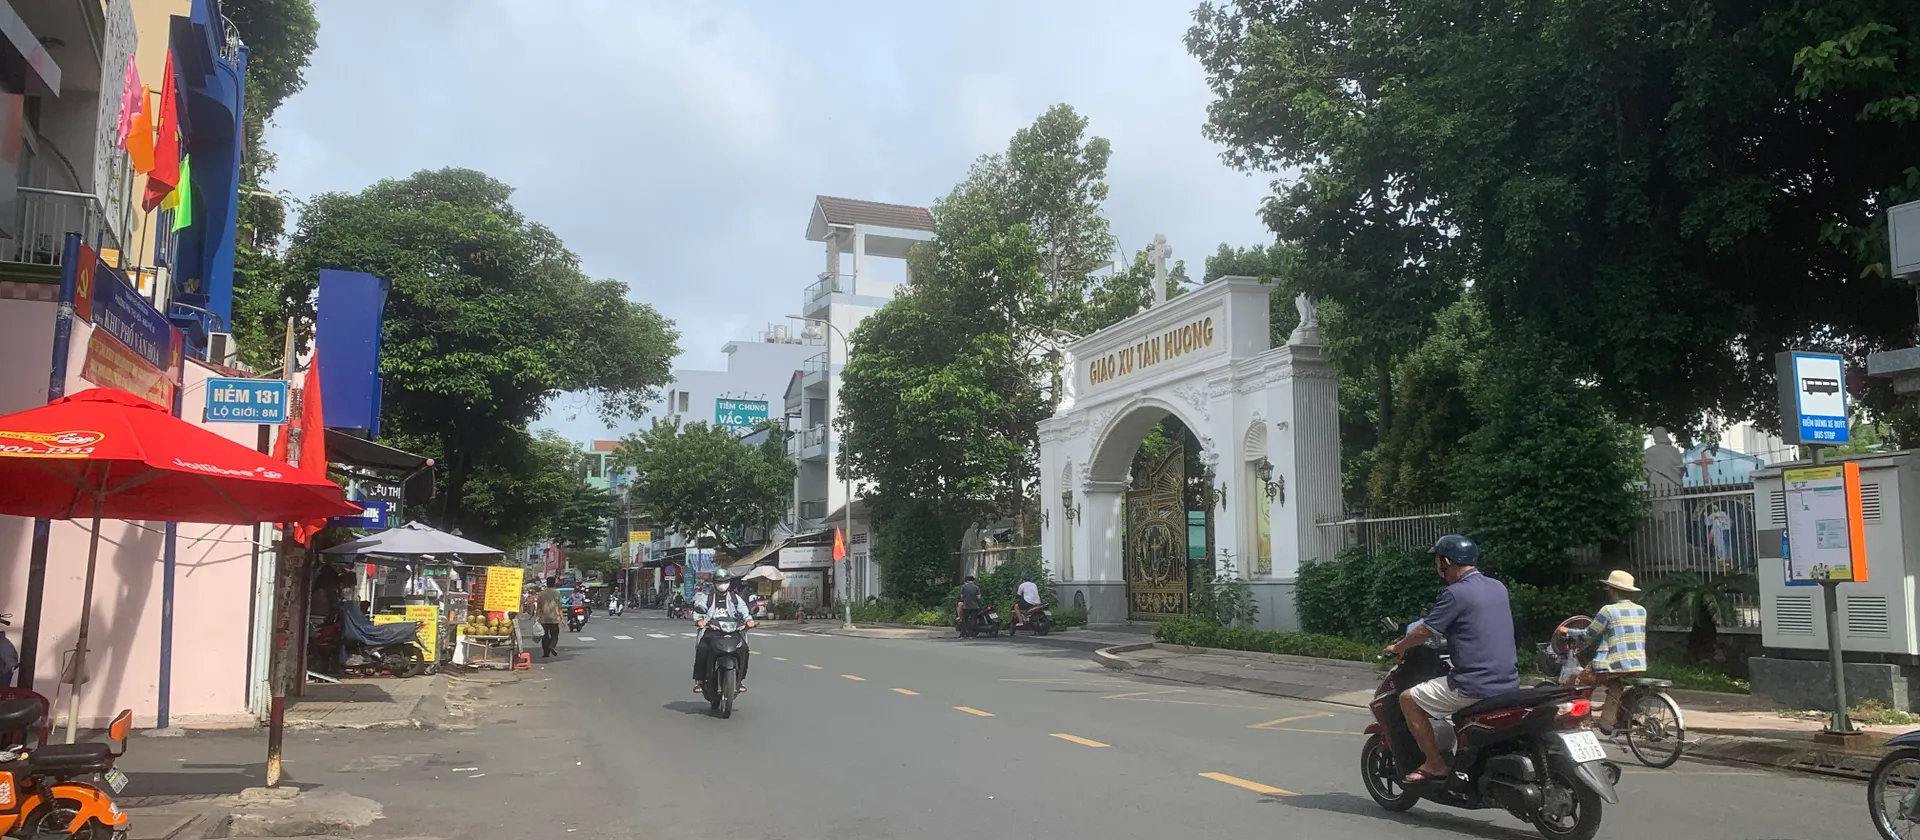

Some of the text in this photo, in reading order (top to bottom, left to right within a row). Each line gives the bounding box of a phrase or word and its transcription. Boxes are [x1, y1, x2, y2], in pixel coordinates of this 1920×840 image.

[104, 309, 120, 335] KHU
[120, 322, 134, 347] PHỐ
[134, 332, 147, 357] VĂN
[213, 384, 279, 404] HẺM 131
[213, 405, 278, 417] LỘ GIỚI: 8M
[172, 458, 254, 476] Jollibee
